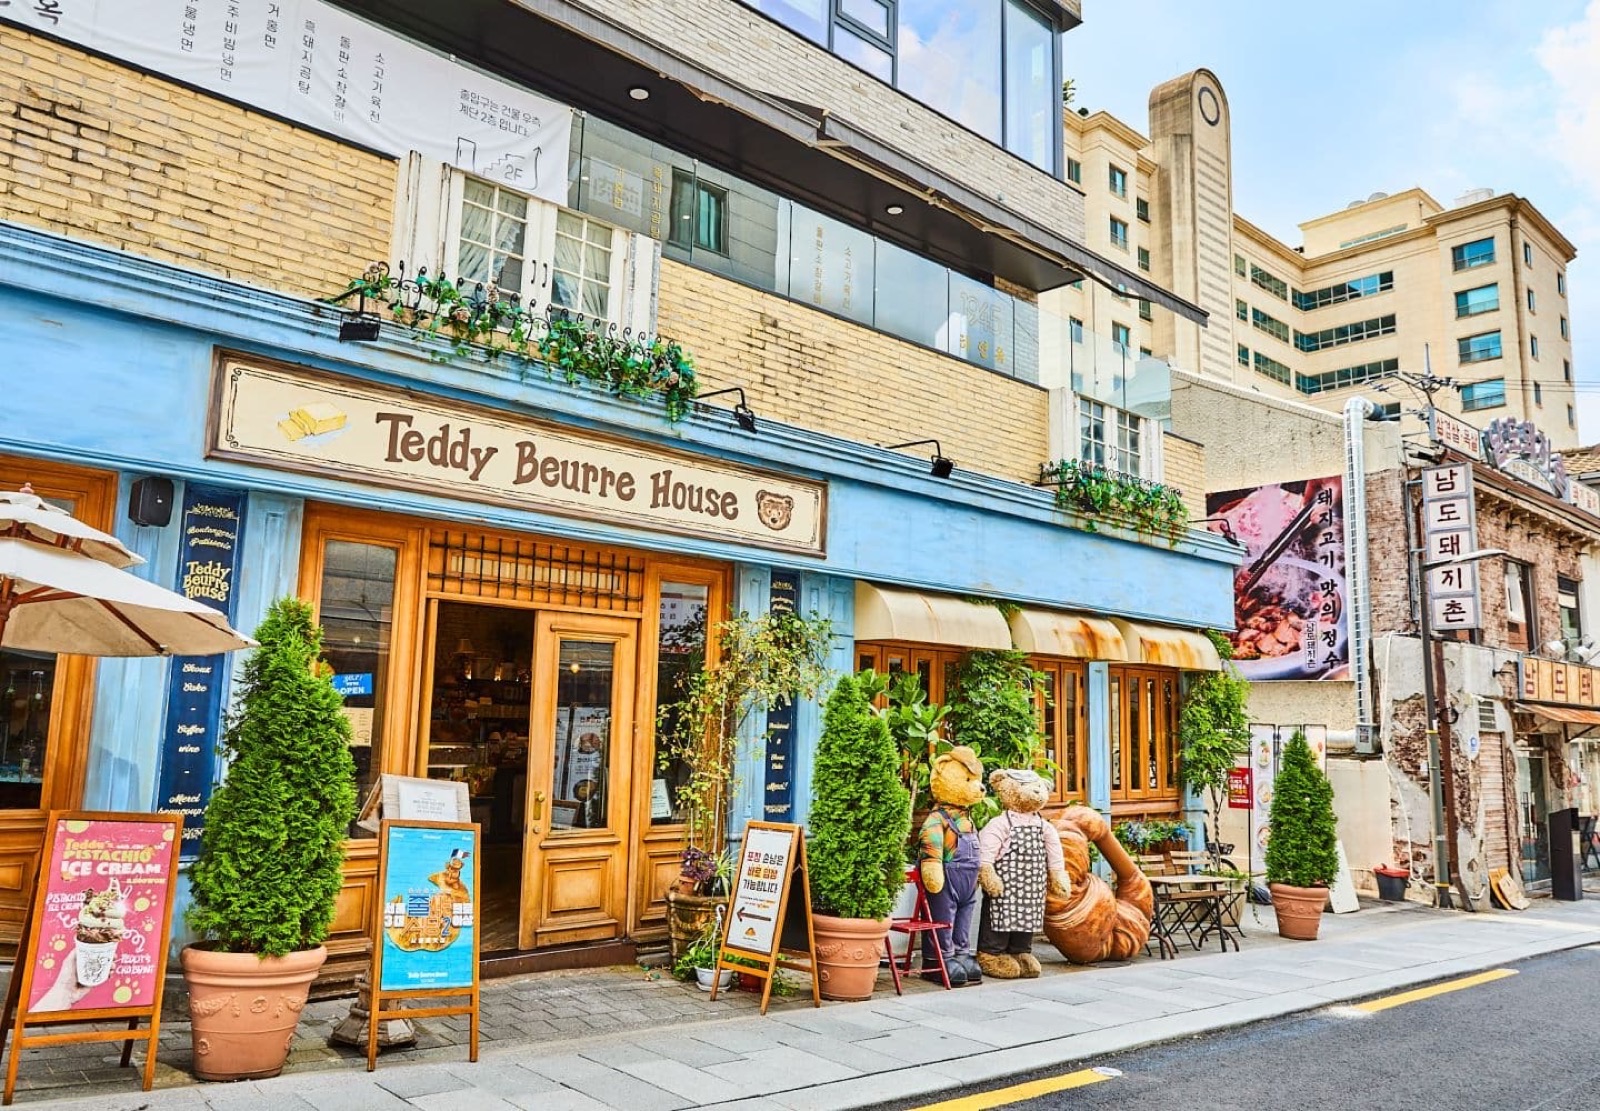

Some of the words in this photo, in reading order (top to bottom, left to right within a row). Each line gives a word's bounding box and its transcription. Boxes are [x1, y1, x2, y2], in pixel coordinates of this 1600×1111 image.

[180, 0, 198, 52] 물냉면
[220, 0, 239, 82] 주비빔냉면
[370, 52, 385, 123] 소고기육전
[459, 102, 479, 120] 계단
[480, 111, 497, 127] 2층
[460, 89, 499, 113] 출입구는
[502, 104, 520, 121] 건물
[504, 163, 524, 181] 2F
[376, 412, 498, 481] Teddy
[512, 440, 636, 502] Beurre
[649, 469, 739, 521] House
[1318, 488, 1337, 570] 돼지고기
[1435, 469, 1466, 623] 남도돼지촌
[182, 574, 229, 591] Beurre
[186, 560, 231, 580] Teddy
[185, 586, 226, 602] House
[1319, 579, 1338, 619] 맛의
[1320, 629, 1341, 670] 정수
[61, 860, 92, 876] ICE
[96, 862, 161, 875] CREAM
[63, 849, 152, 863] PISTACHIO
[747, 851, 761, 862] 포장
[763, 853, 784, 866] 손님은
[743, 879, 778, 893] 가능합니다
